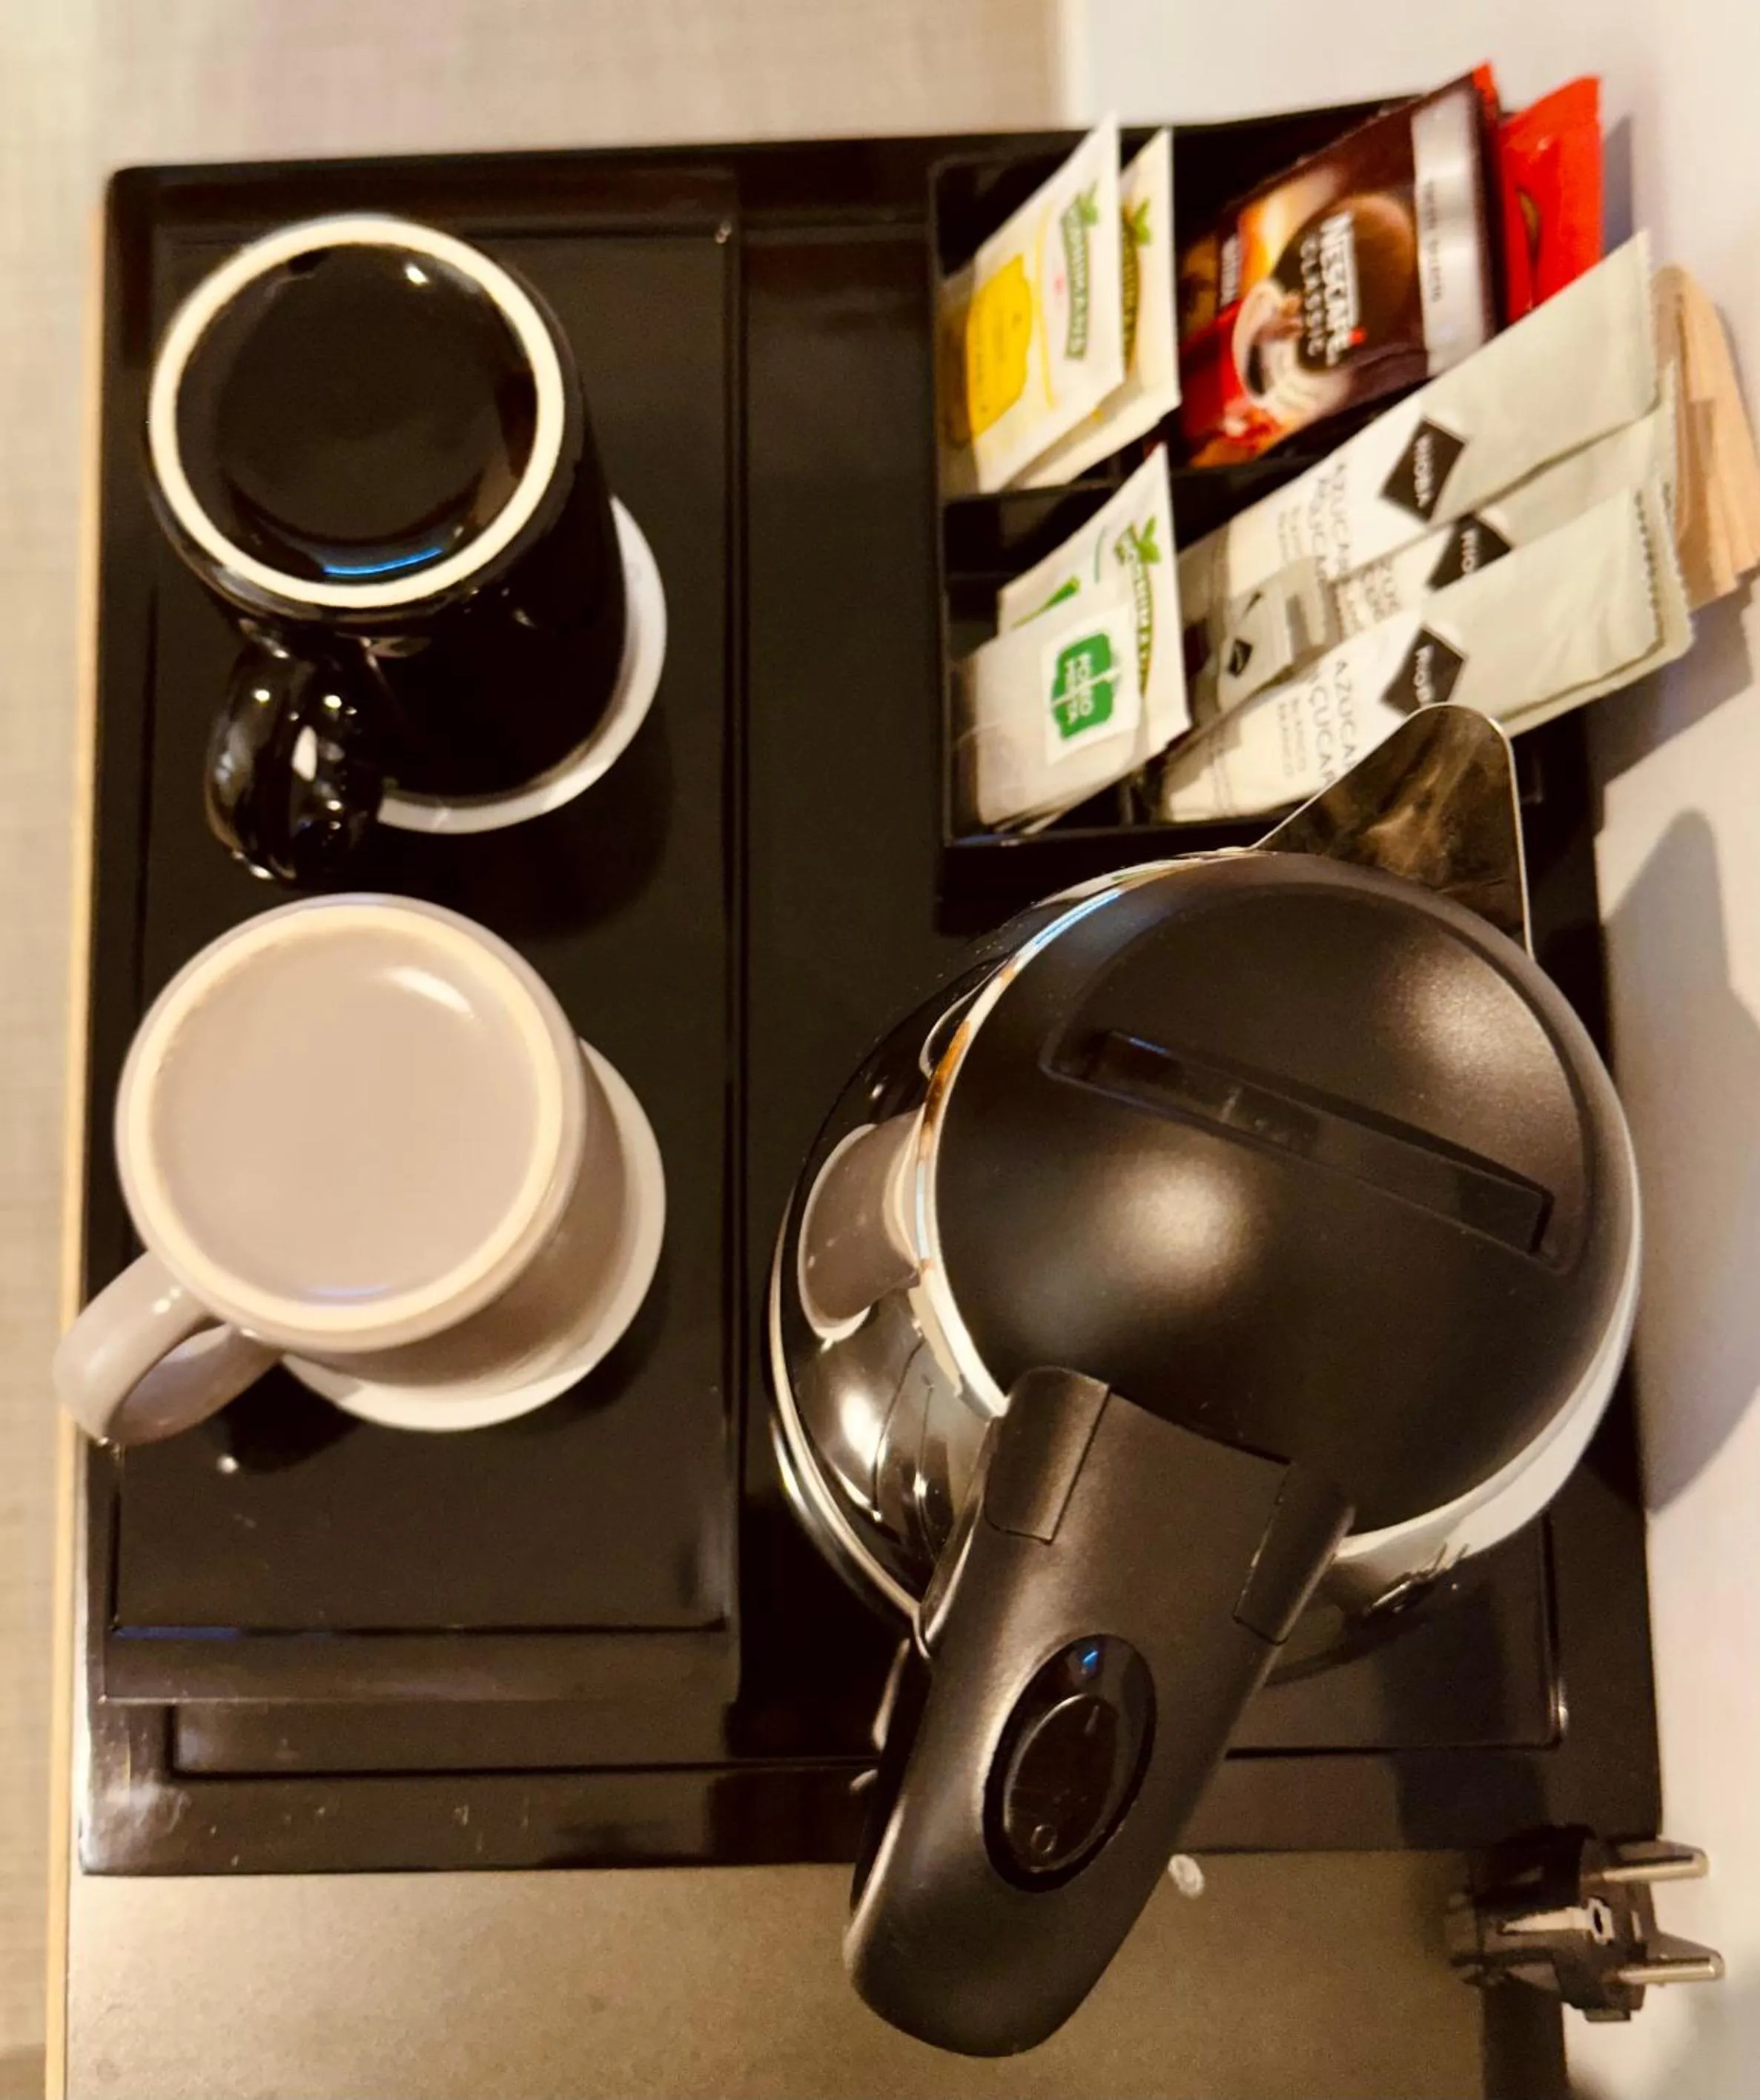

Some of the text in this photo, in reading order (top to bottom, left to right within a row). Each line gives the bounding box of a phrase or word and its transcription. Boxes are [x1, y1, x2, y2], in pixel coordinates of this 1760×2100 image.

[1301, 233, 1325, 357] CLASSIC
[1413, 431, 1435, 508] RIOBA
[1460, 527, 1480, 574] RIO
[1413, 643, 1435, 707] RIOB
